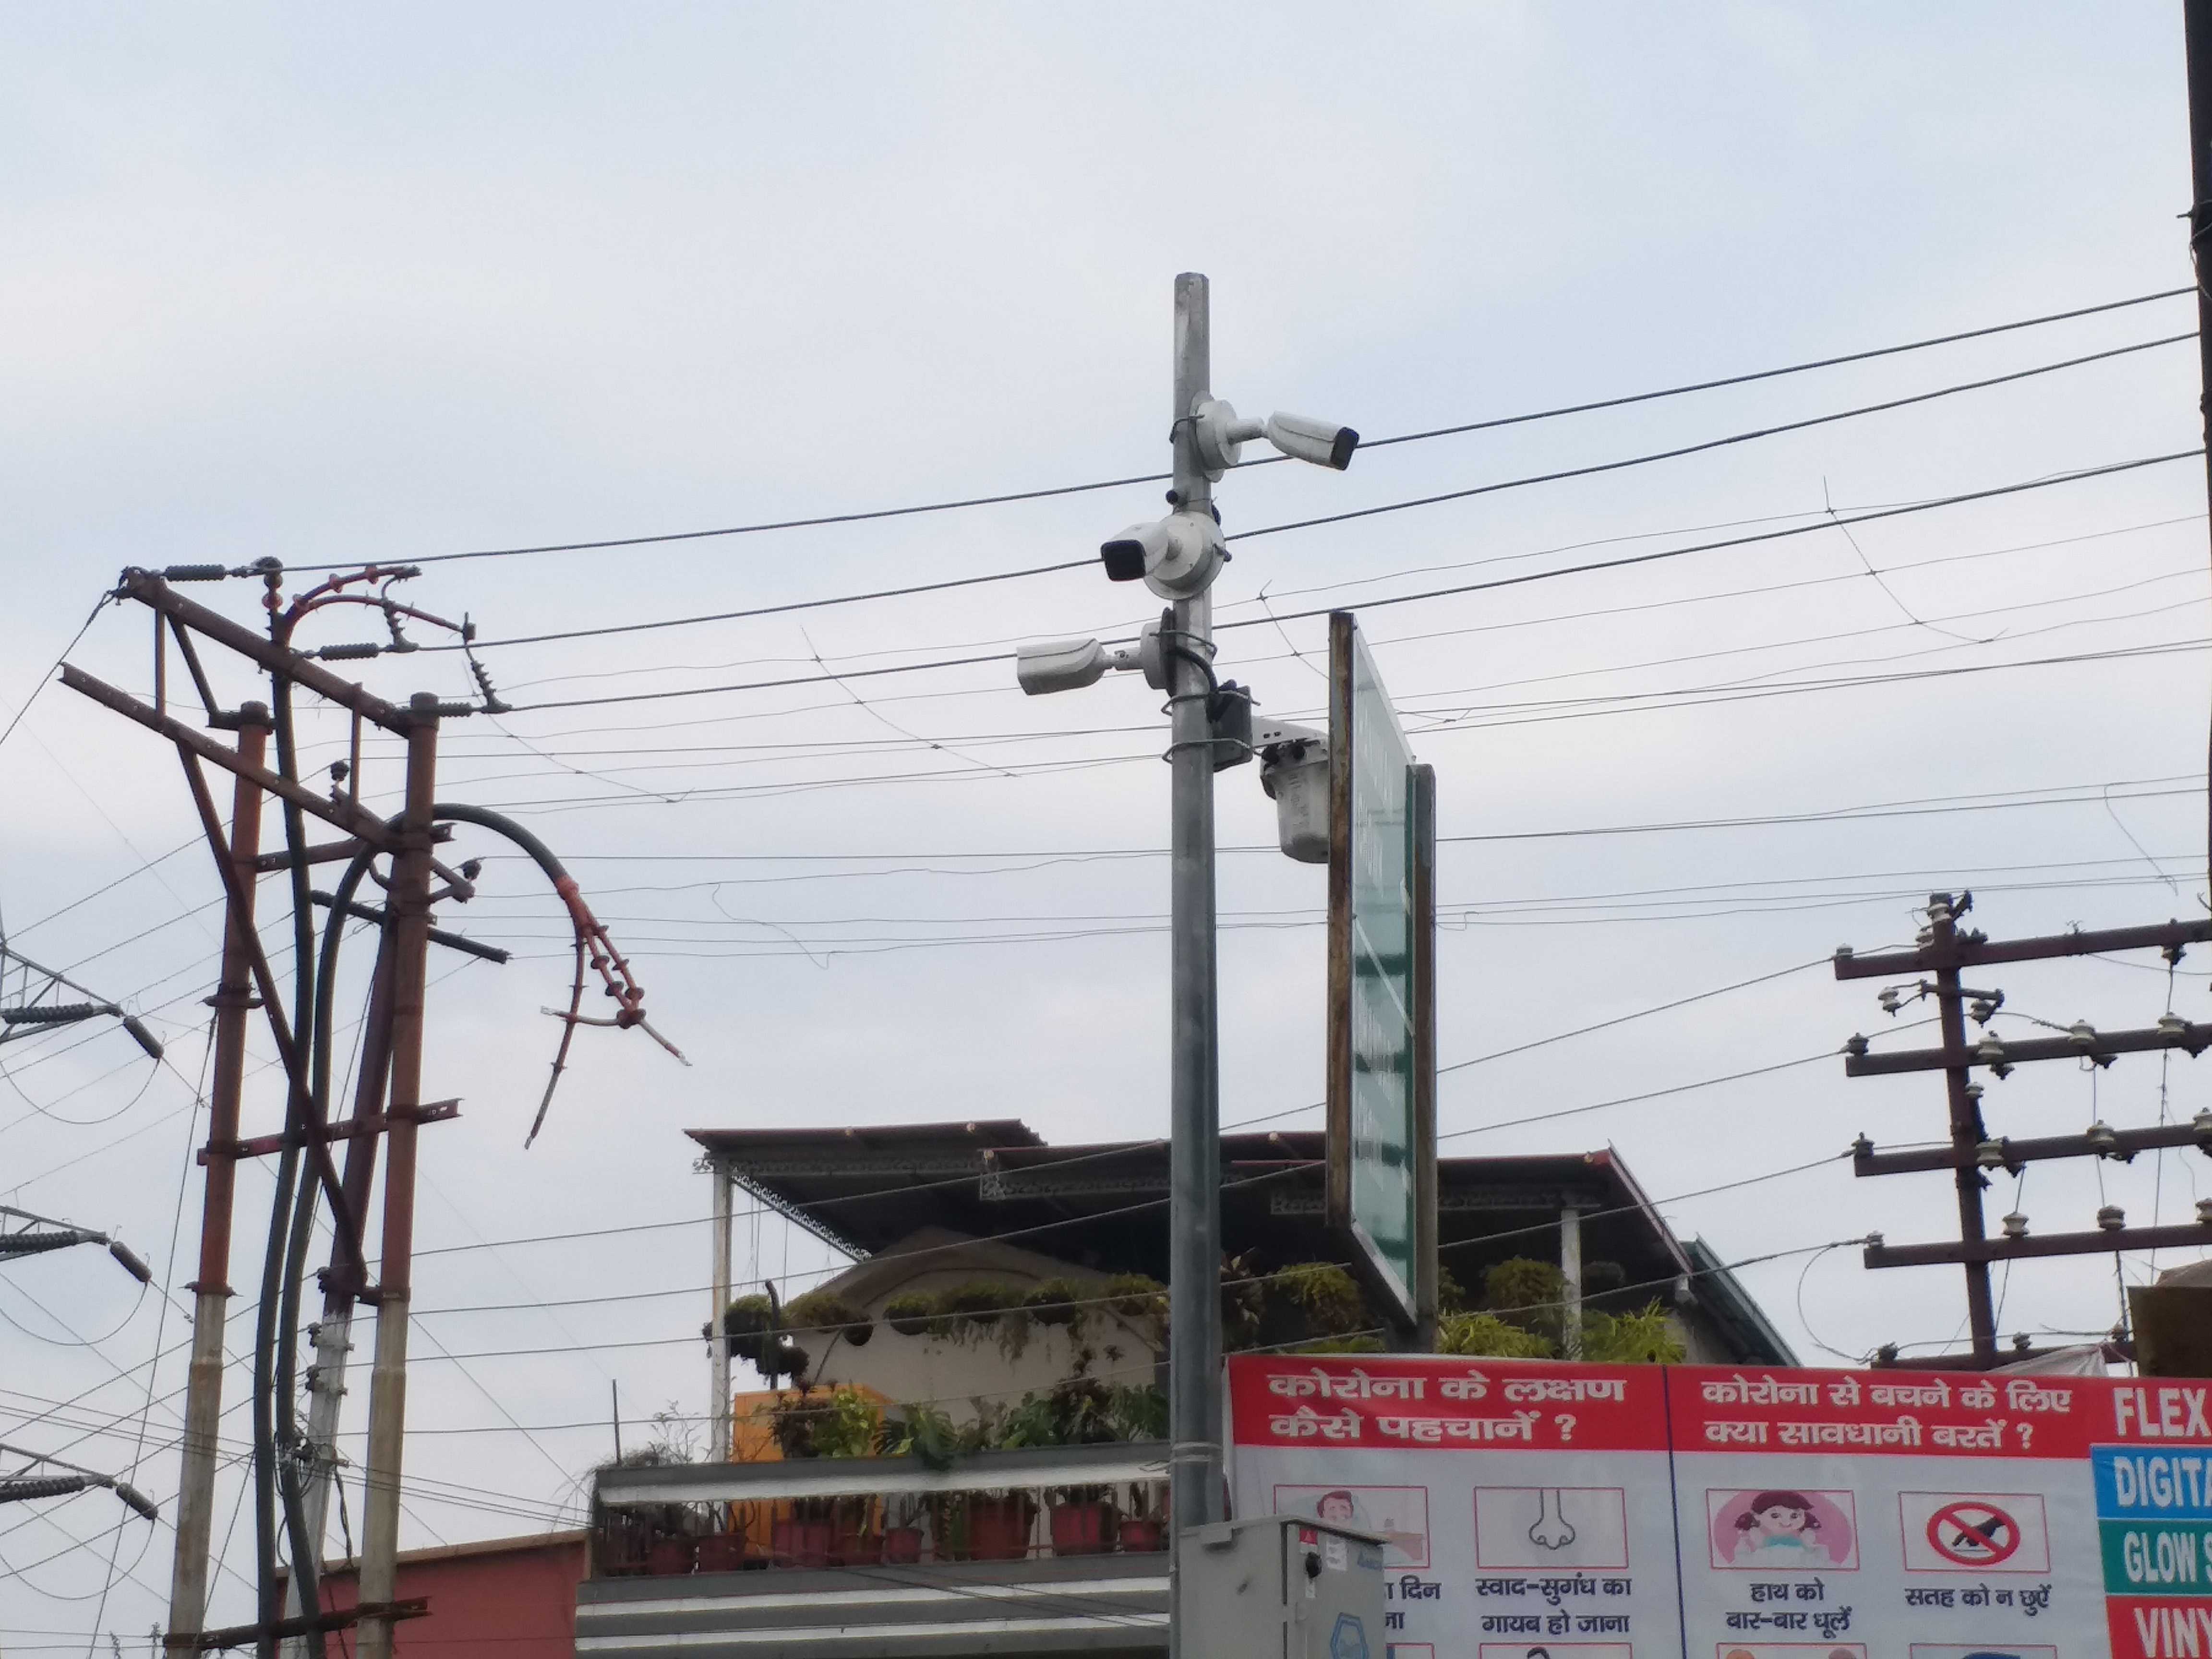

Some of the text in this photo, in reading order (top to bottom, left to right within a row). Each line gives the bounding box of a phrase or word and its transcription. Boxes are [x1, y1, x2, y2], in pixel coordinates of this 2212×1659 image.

[1267, 1367, 1628, 1402] कोरोना के लक्षण
[1701, 1373, 2072, 1412] कोरोना से बचने के लिए
[1269, 1405, 1577, 1442] कैसे पहचानें ?
[2113, 1387, 2212, 1436] FLEX
[1703, 1415, 2033, 1449] क्या सावधानी बरतें ?
[2124, 1531, 2196, 1583] GLOW
[1399, 1574, 1442, 1599] दिन
[1475, 1572, 1632, 1605] स्वाद-सुगंध का
[1750, 1576, 1825, 1602] हाथ को
[1905, 1588, 1955, 1608] सतह
[1960, 1582, 1990, 1606] को
[1995, 1590, 2014, 1606] न
[1480, 1609, 1630, 1635] गायब हो जाना
[1726, 1611, 1809, 1629] बार-बार
